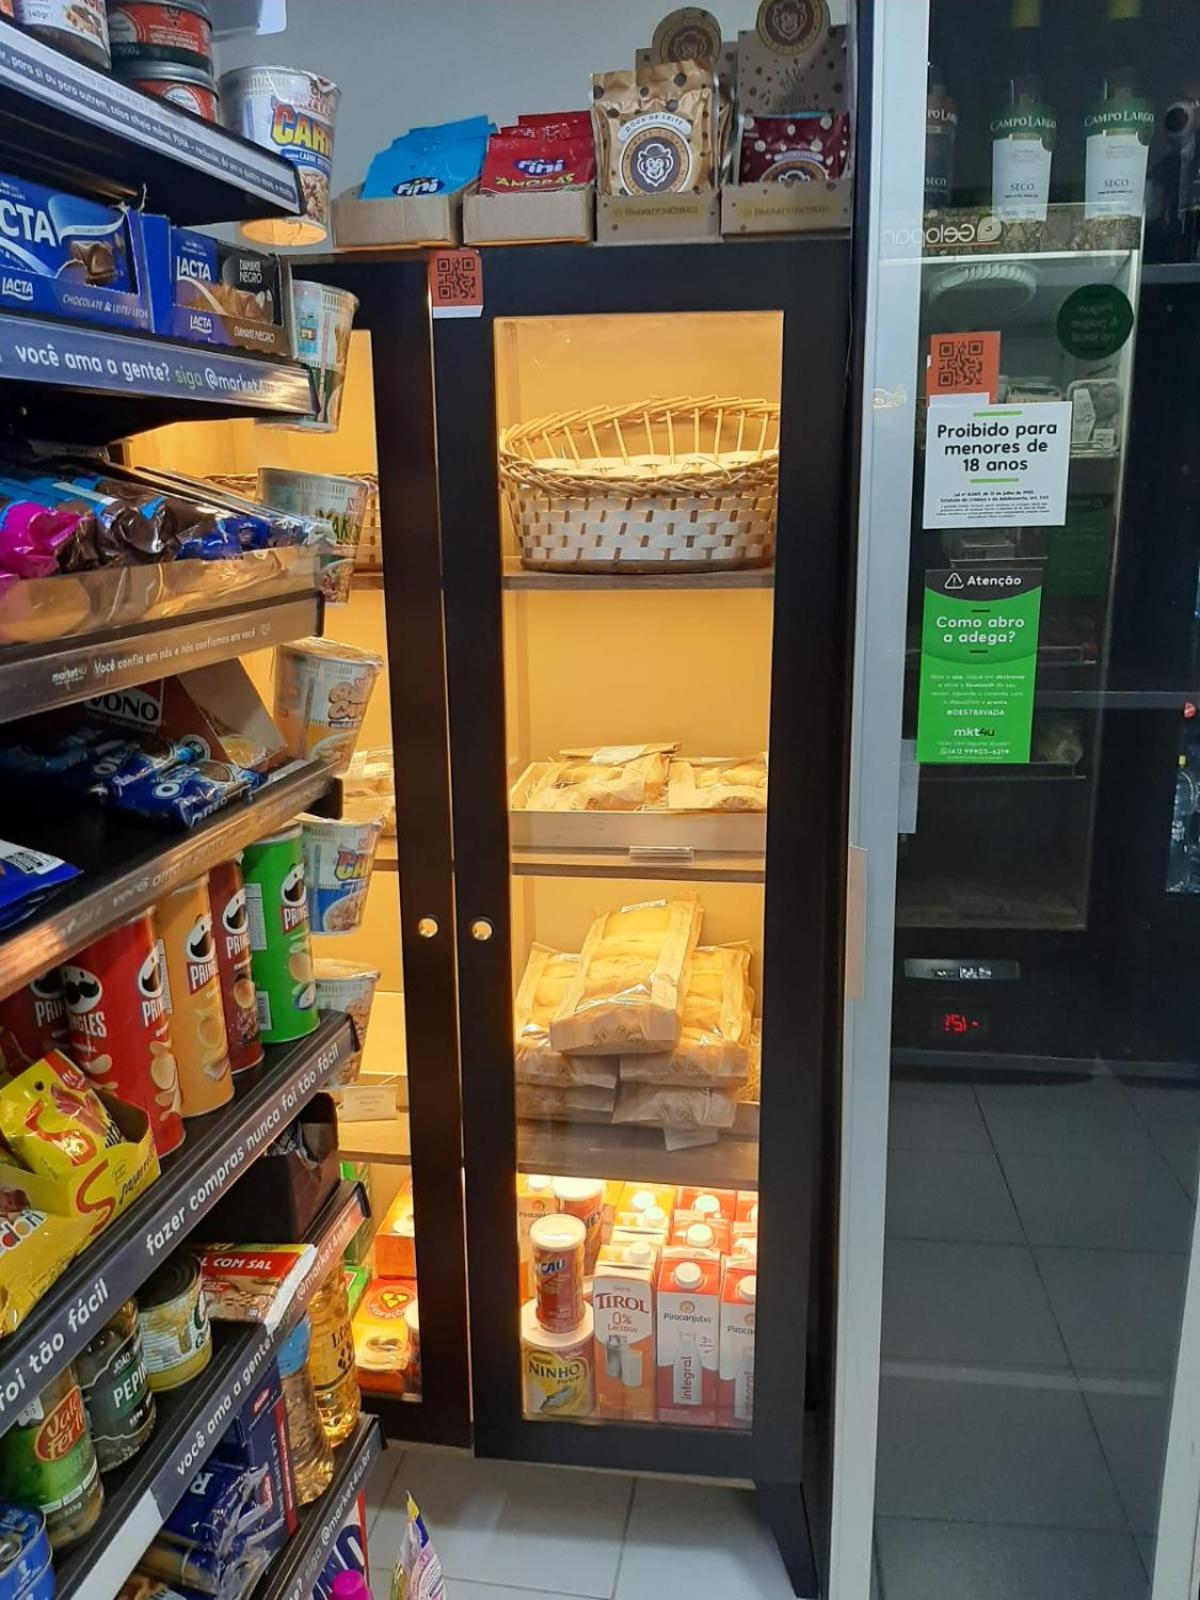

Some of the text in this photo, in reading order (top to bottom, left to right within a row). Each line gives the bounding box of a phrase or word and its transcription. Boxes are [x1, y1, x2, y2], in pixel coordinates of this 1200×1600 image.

[990, 115, 1057, 131] CAMPO LARGO
[1085, 111, 1155, 127] CAMPO LARGO
[518, 159, 564, 174] Fini
[397, 178, 440, 196] Fini
[1010, 182, 1034, 192] SECO
[1103, 178, 1129, 188] SECO
[0, 199, 57, 247] CTA
[176, 256, 212, 281] LACTA
[239, 271, 263, 284] NEGRO
[2, 276, 34, 296] LACTA
[62, 294, 103, 311] CHOCOLATE
[104, 301, 112, 312] &
[190, 314, 212, 330] LACTA
[255, 330, 275, 343] NEGRO
[15, 343, 60, 367] você
[65, 353, 102, 373] ama
[107, 358, 118, 375] a
[122, 361, 171, 382] gente?
[175, 366, 203, 390] siga
[937, 422, 1057, 439] Proibido para
[944, 438, 1048, 455] menores de
[962, 458, 1028, 472] 18 anos
[967, 575, 1021, 588] Atenção
[936, 616, 1024, 628] Como abro
[943, 631, 1016, 645] a adega?
[94, 659, 116, 675] Você
[117, 654, 144, 669] confia
[145, 653, 158, 663] em
[159, 648, 173, 660] nós
[181, 643, 194, 655] nós
[195, 636, 229, 651] confiamos
[241, 628, 256, 640] você
[954, 727, 995, 737] mkt4u
[146, 1207, 185, 1256] fazer
[189, 1147, 245, 1211] compras
[247, 1111, 280, 1150] nunca
[281, 1088, 298, 1113] foi
[298, 1073, 316, 1095] tão
[317, 1045, 339, 1075] fácil
[213, 1257, 272, 1270] COM SAL
[595, 1293, 649, 1314] TIROL
[29, 1332, 64, 1374] tão
[68, 1278, 109, 1334] fácil
[612, 1311, 632, 1325] 0%
[663, 1312, 712, 1324] Piracanjuba
[528, 1360, 580, 1378] NINHO
[681, 1356, 694, 1400] integral
[177, 1430, 206, 1475] você
[207, 1395, 232, 1434] ama
[233, 1380, 242, 1396] a
[320, 1449, 371, 1545] @market4u.br
